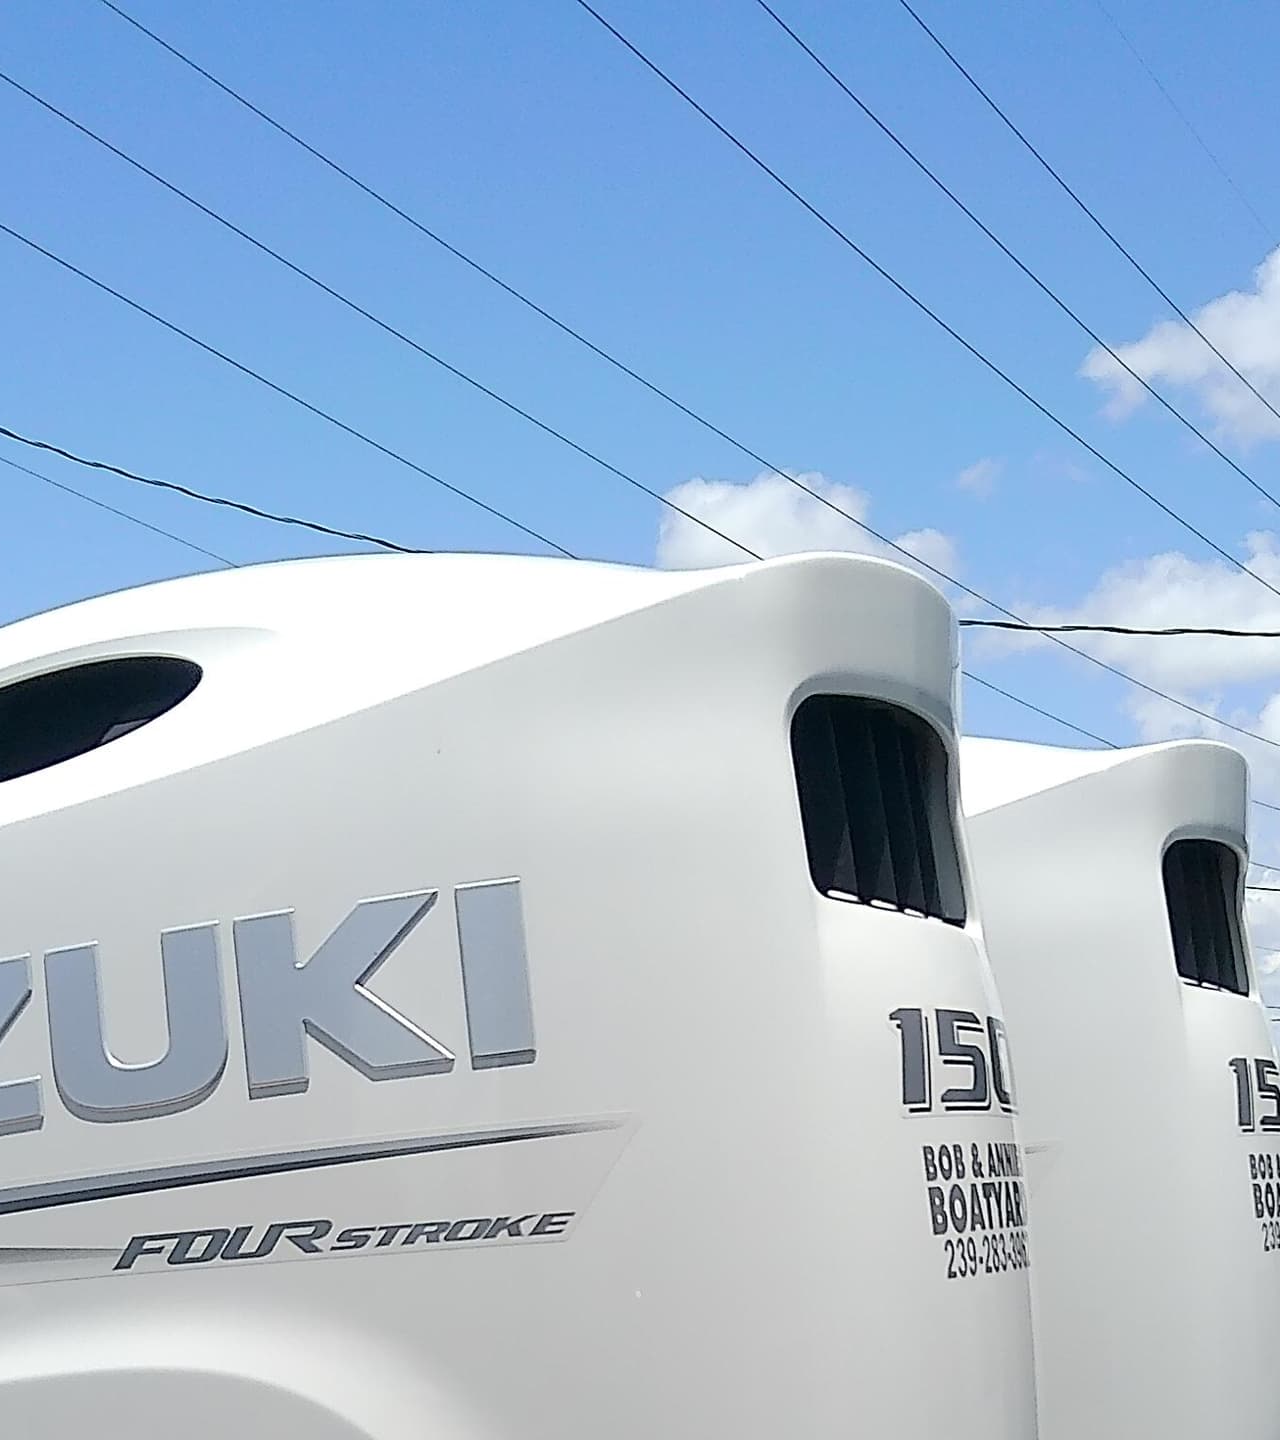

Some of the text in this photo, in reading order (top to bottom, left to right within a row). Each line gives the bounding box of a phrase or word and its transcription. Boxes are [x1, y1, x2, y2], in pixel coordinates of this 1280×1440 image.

[923, 1144, 965, 1181] BOB
[971, 1143, 984, 1178] &
[1249, 1153, 1274, 1180] BOB
[113, 1211, 575, 1271] FOUR STROKE
